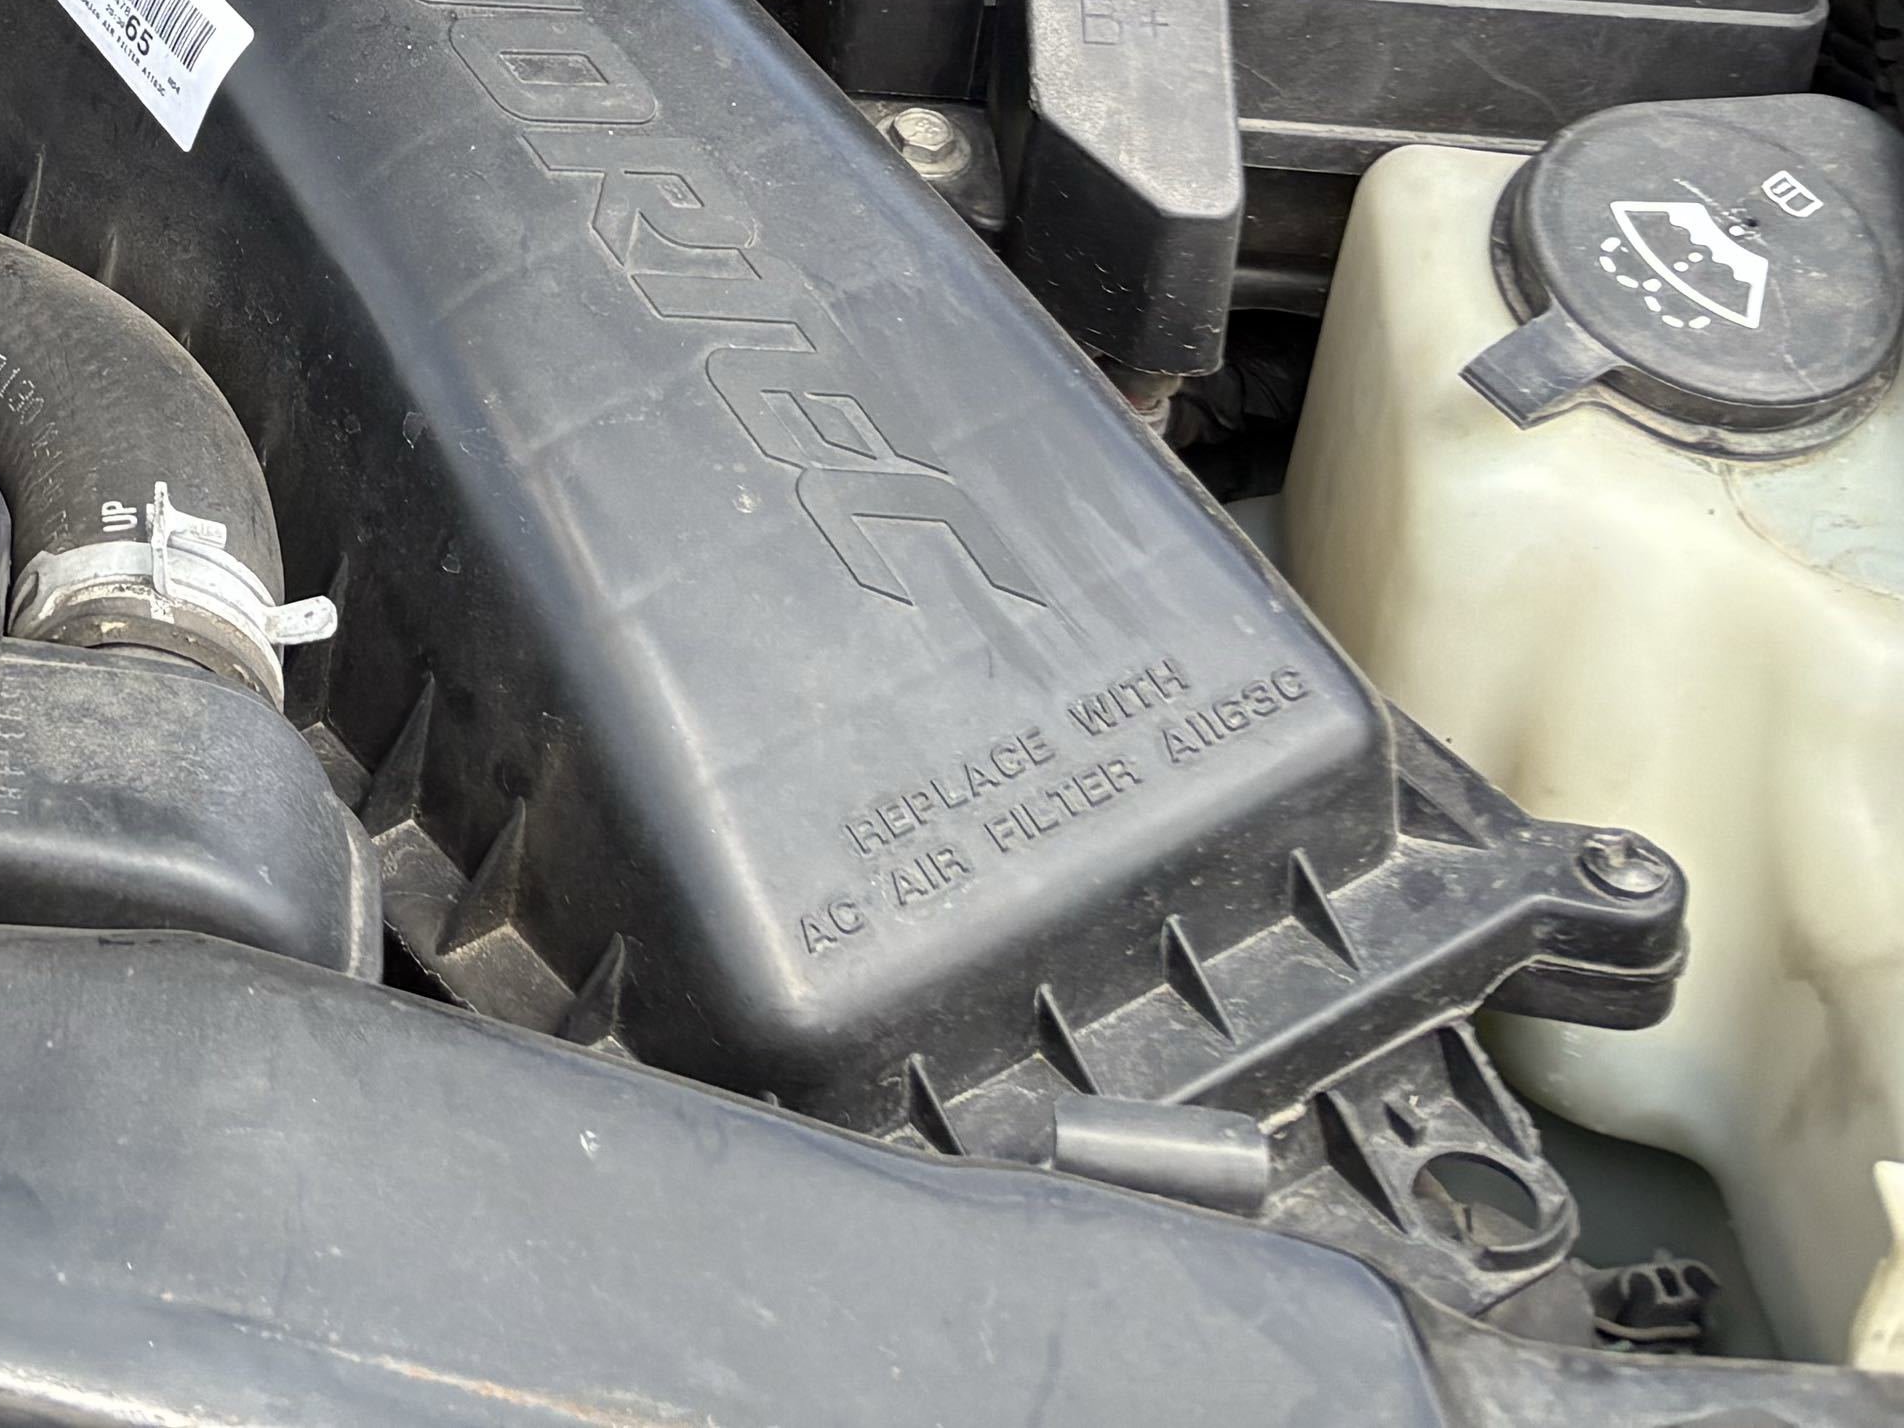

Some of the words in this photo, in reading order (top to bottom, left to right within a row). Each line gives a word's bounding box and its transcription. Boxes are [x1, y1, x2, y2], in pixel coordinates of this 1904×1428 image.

[101, 498, 138, 535] UP
[798, 896, 868, 955] AC
[890, 846, 971, 907] AIR
[983, 756, 1145, 854] FILTER
[842, 724, 1056, 856] REPLACE
[1065, 657, 1191, 738] WITH
